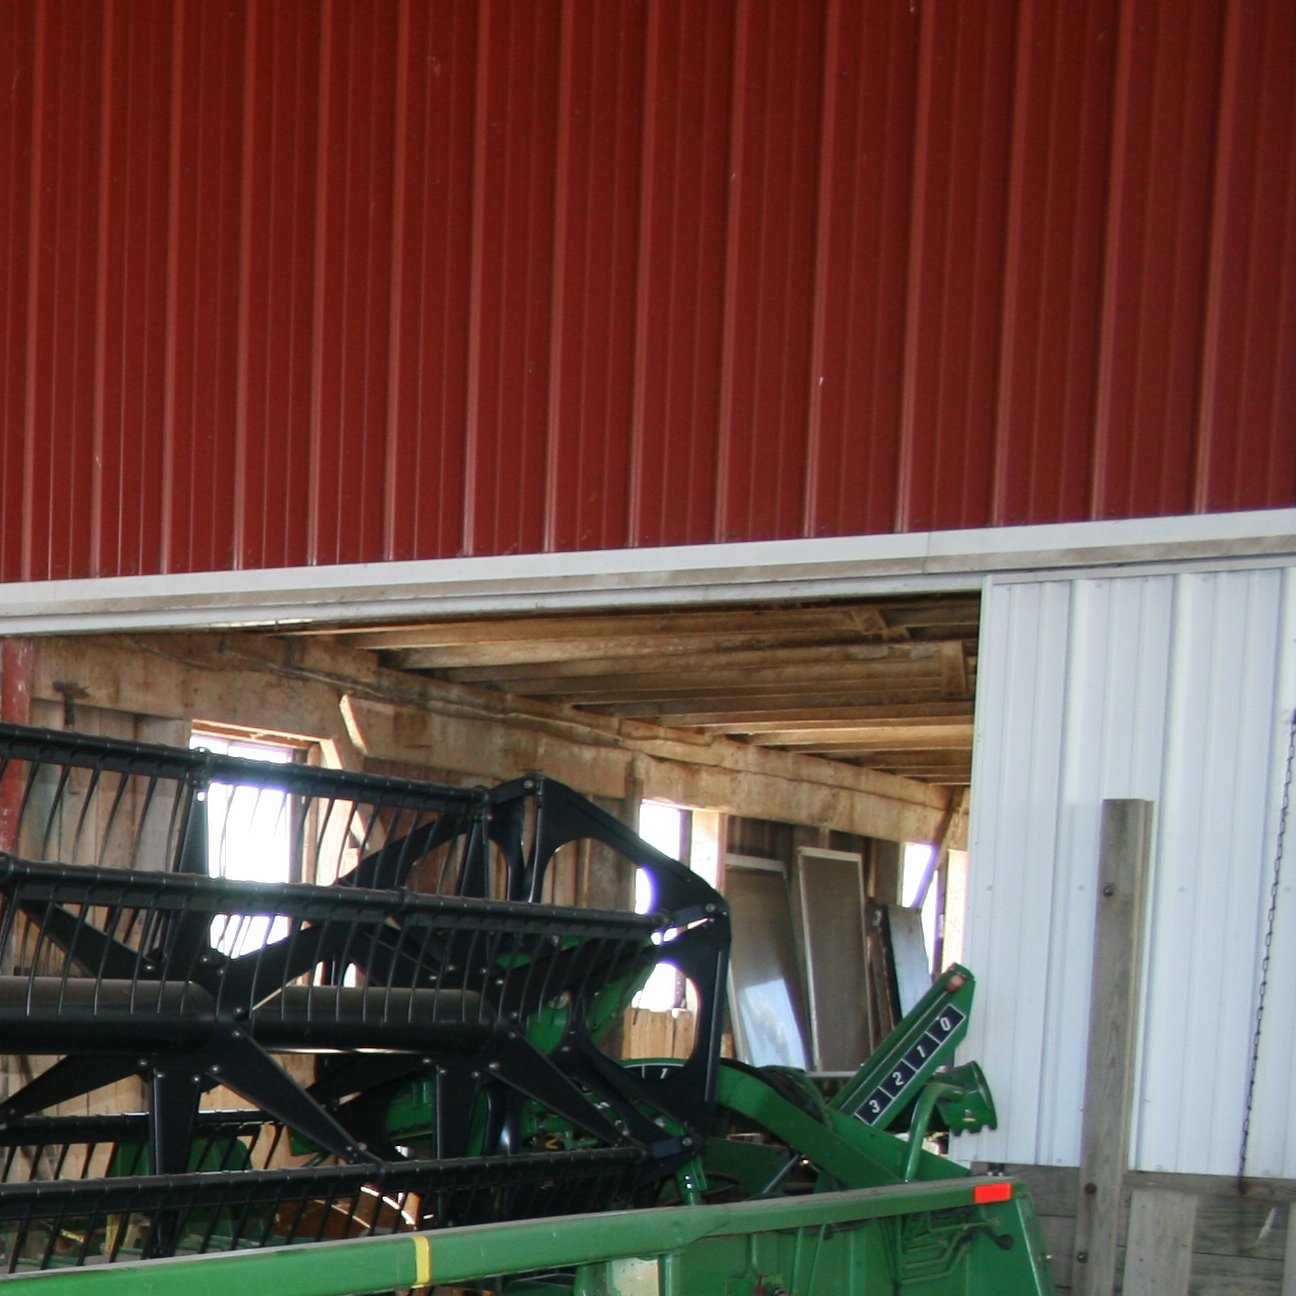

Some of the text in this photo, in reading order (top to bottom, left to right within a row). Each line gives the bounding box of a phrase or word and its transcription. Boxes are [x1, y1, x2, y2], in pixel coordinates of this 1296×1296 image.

[940, 1017, 951, 1031] 0
[916, 1045, 926, 1058] 1
[892, 1071, 904, 1086] 2
[869, 1099, 881, 1113] 3
